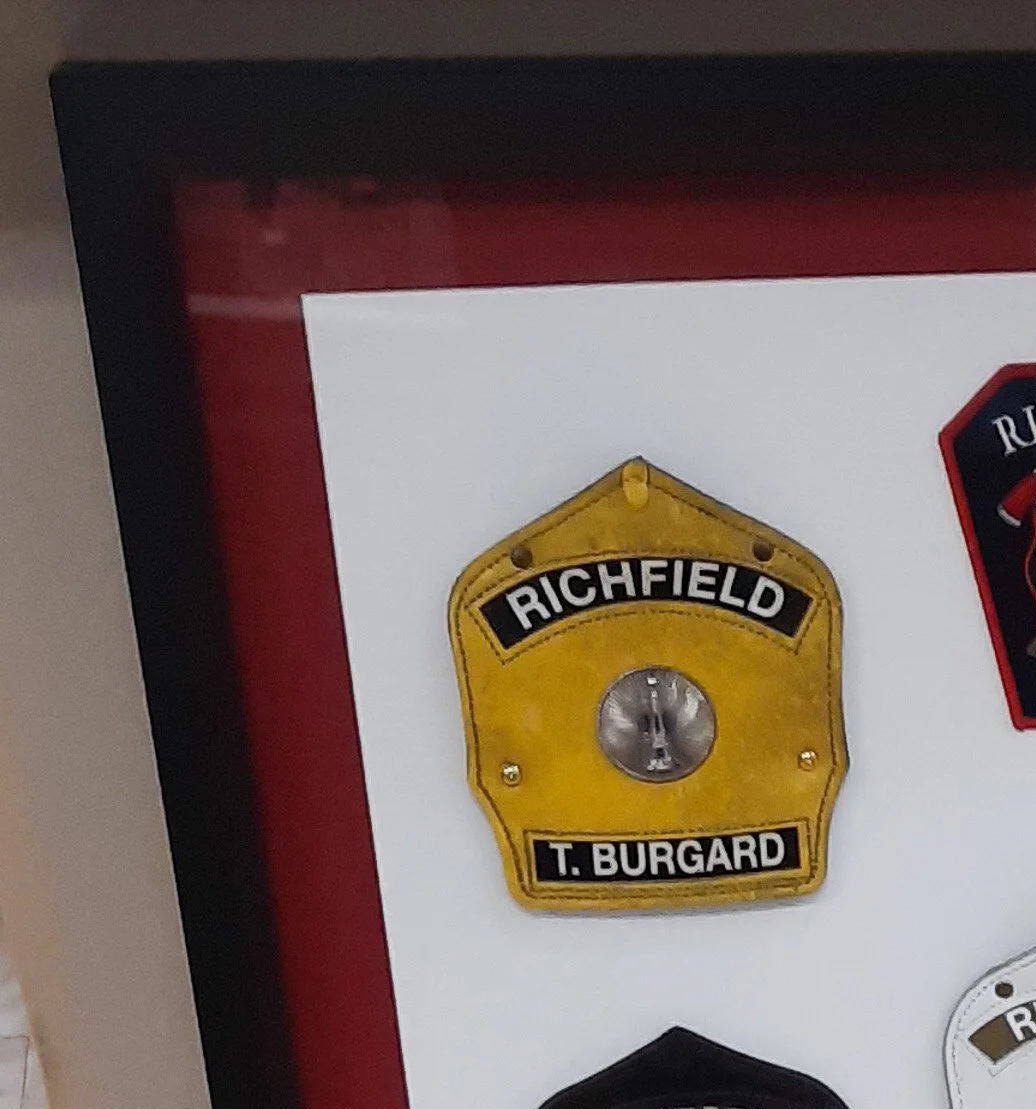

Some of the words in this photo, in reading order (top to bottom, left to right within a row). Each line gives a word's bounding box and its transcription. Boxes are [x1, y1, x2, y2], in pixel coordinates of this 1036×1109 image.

[505, 559, 785, 630] RICHFIELD
[549, 843, 580, 876] T.
[593, 832, 786, 876] BURGARD
